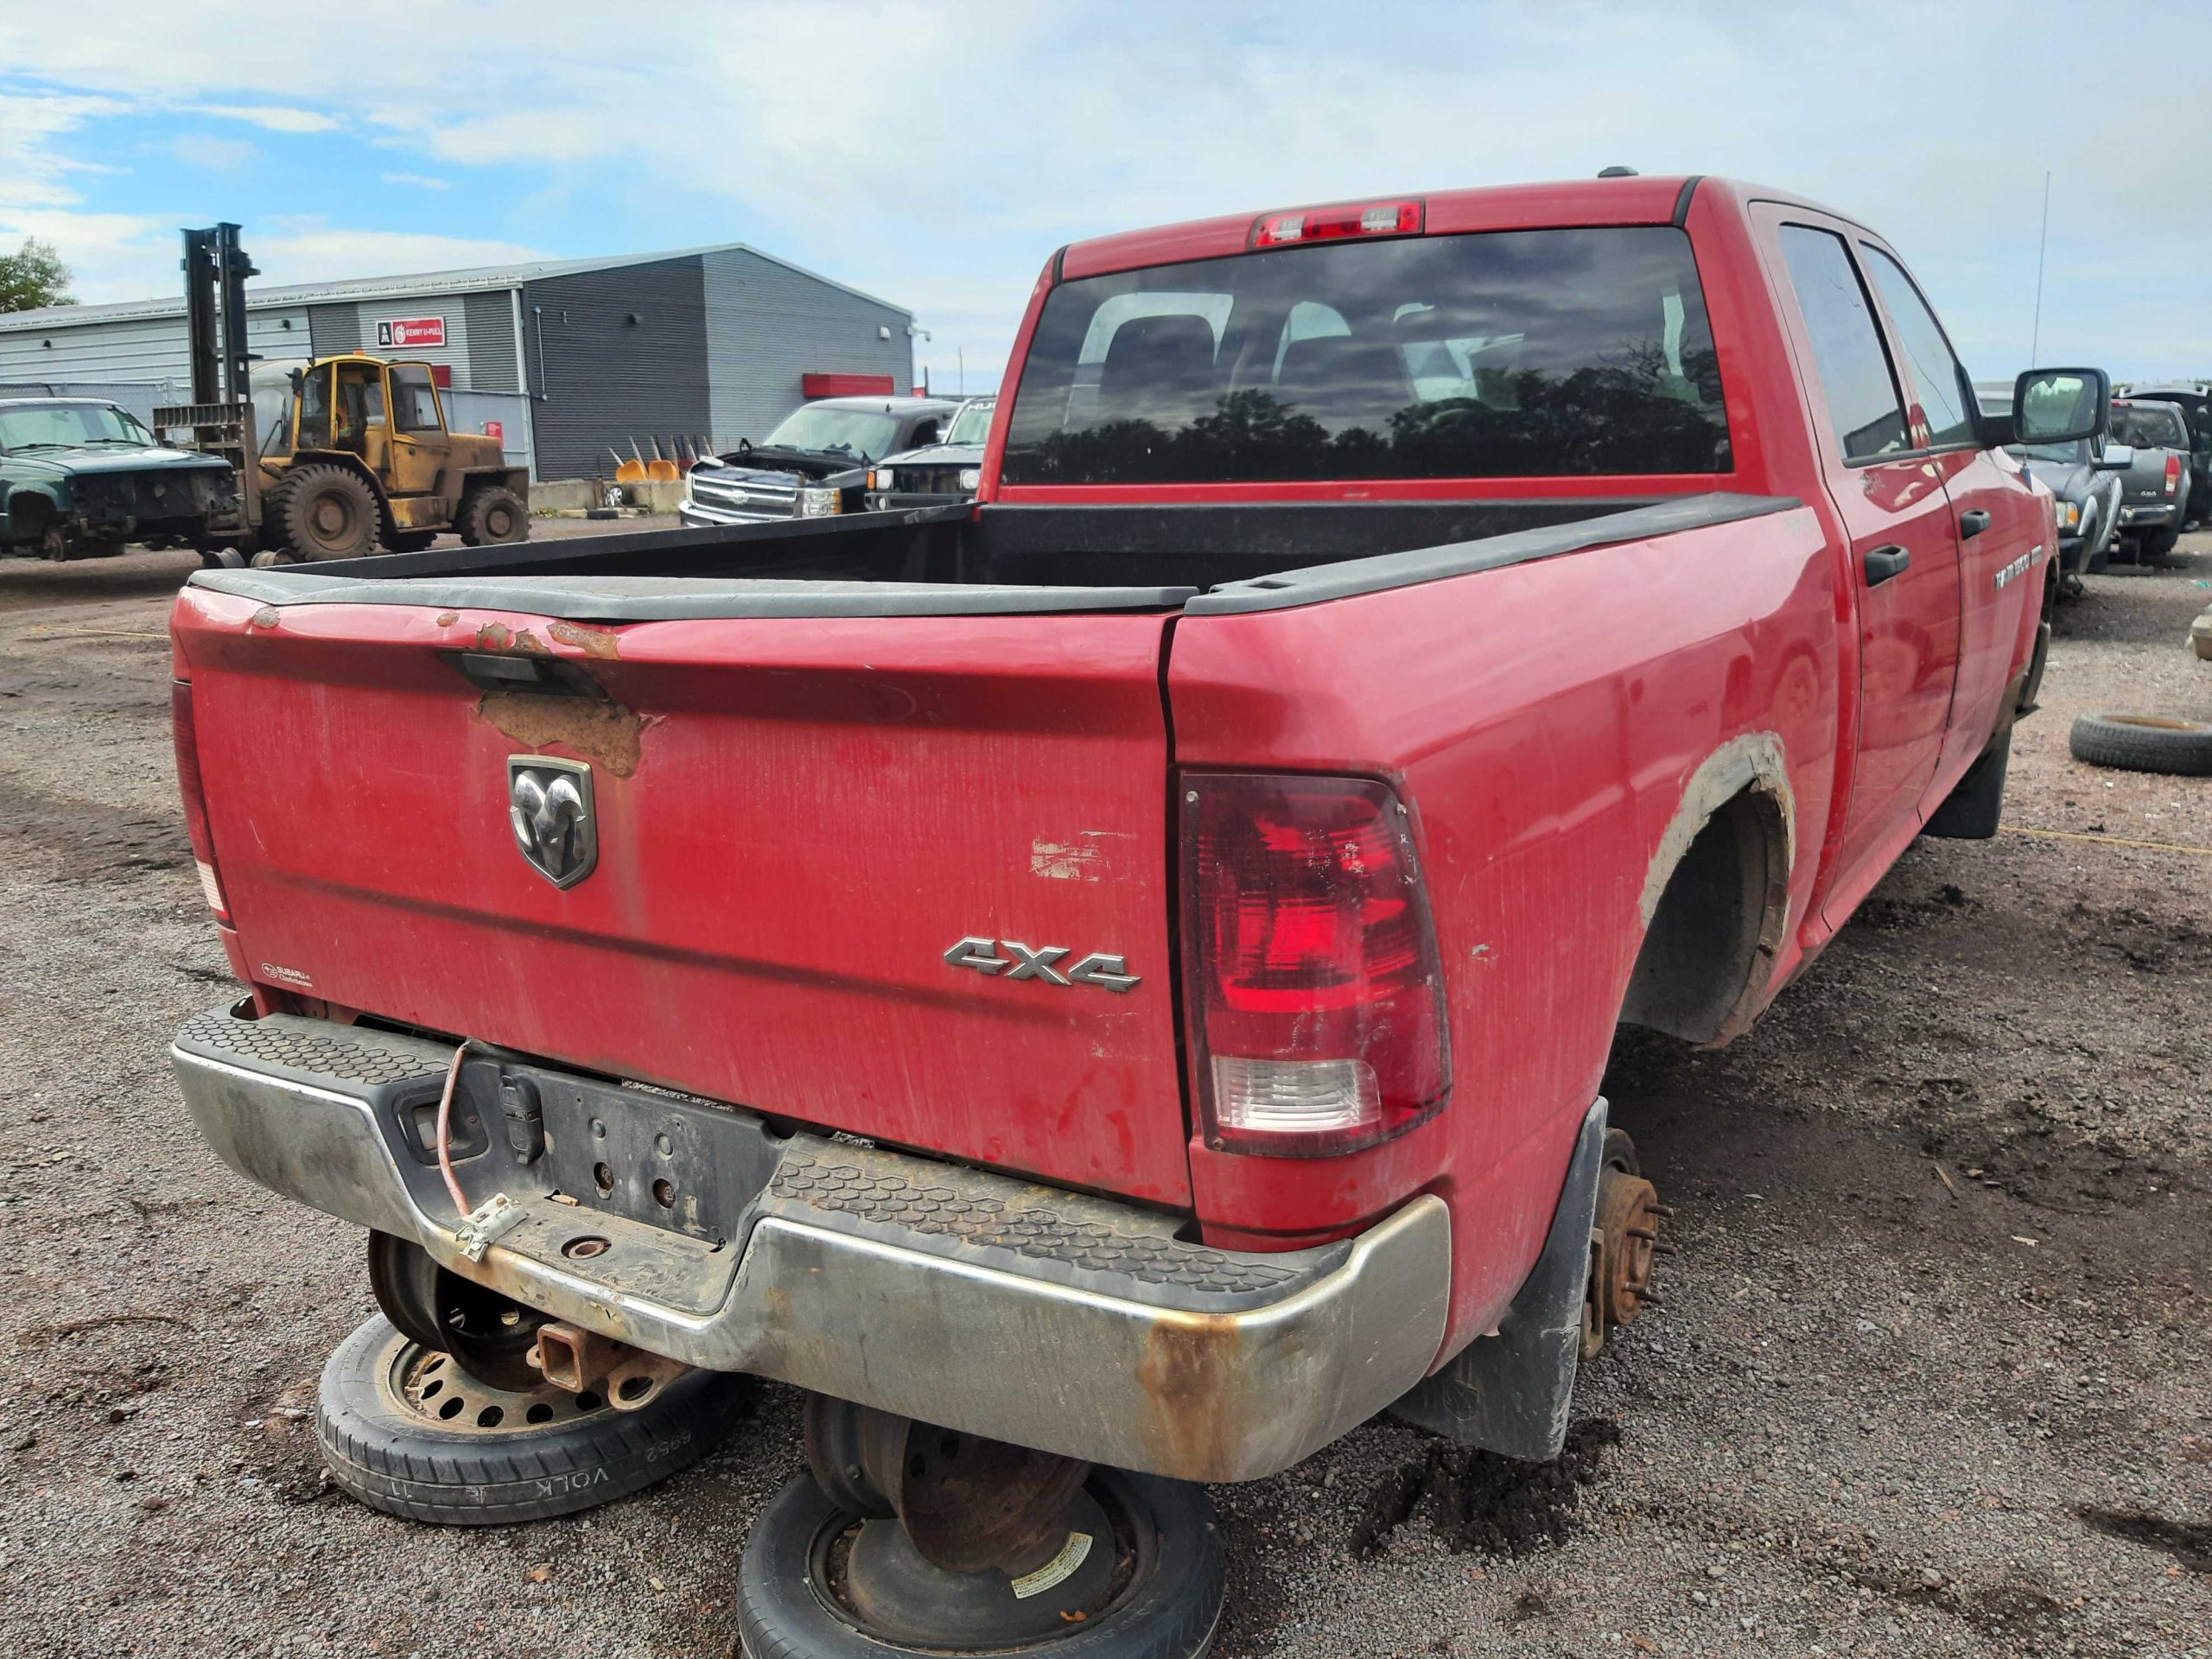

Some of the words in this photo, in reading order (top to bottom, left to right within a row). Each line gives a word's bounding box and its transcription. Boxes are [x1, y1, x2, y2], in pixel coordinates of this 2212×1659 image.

[405, 328, 423, 337] KENNY
[423, 327, 442, 336] U-PULL
[276, 966, 305, 979] SUBARU
[536, 1467, 609, 1497] VOLK
